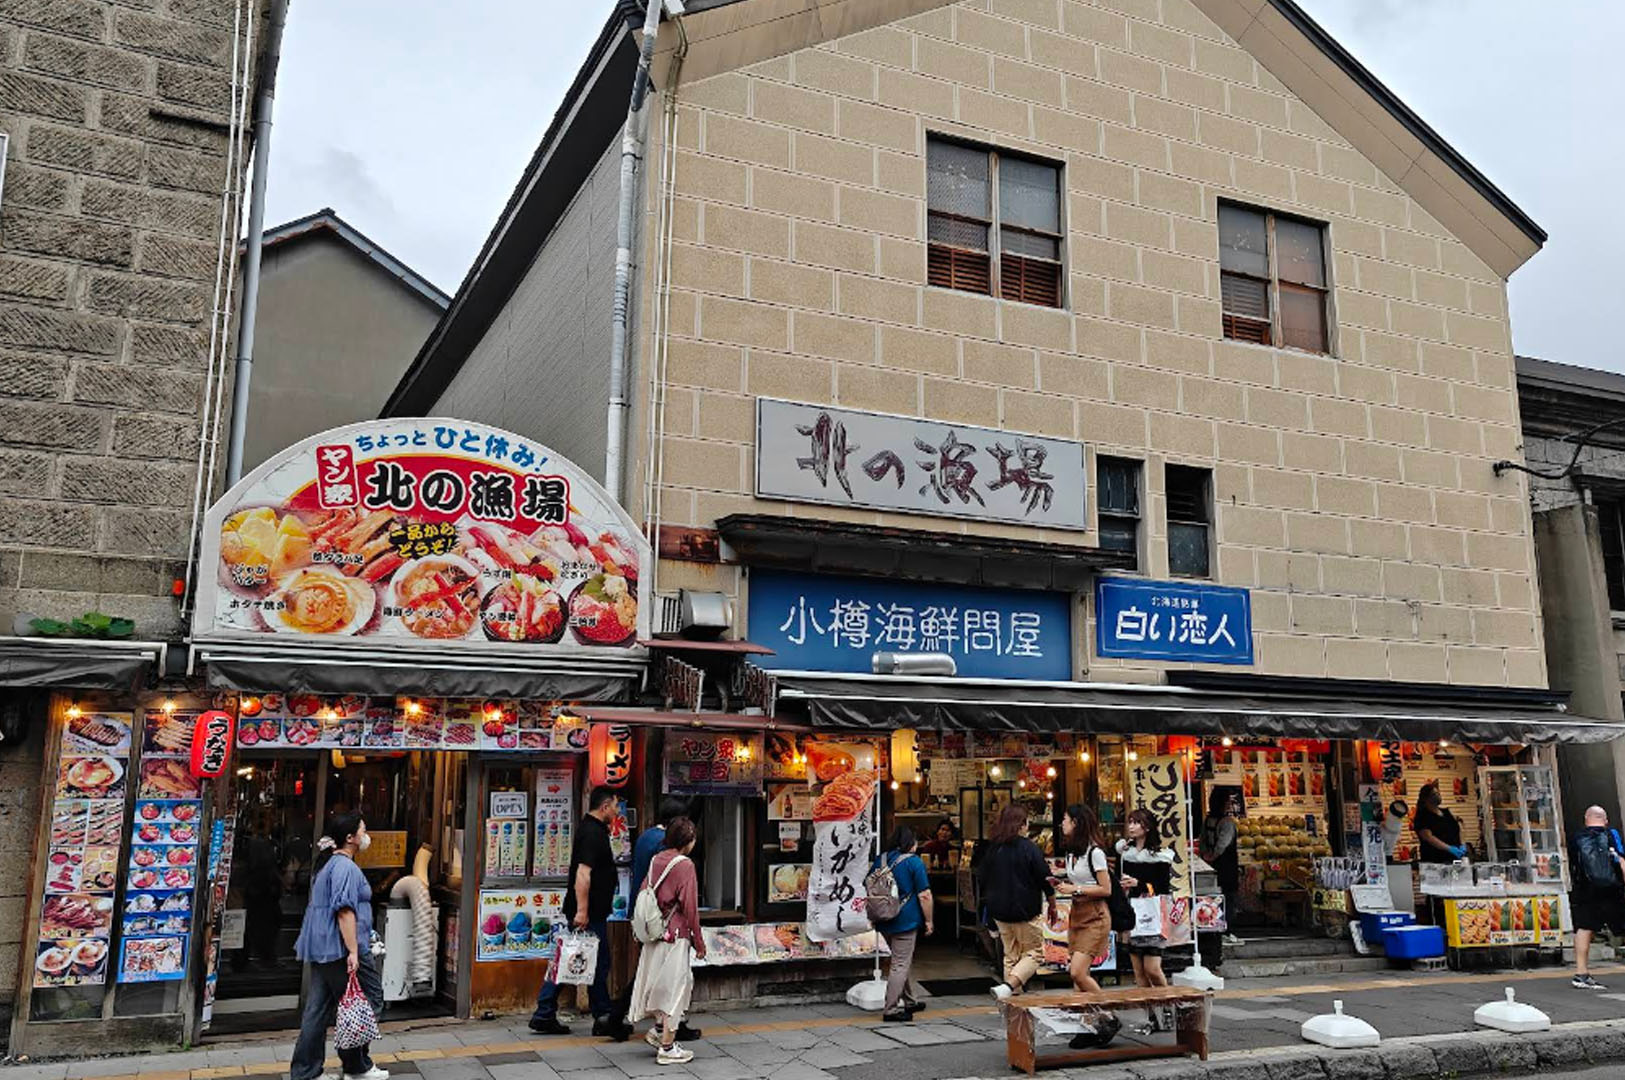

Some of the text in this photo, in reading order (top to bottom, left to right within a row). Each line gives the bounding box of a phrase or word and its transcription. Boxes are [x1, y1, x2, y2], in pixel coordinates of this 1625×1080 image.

[366, 463, 566, 521] 北の漁場
[391, 522, 455, 540] 一品から
[399, 539, 452, 557] どうぞ!
[780, 596, 1044, 658] 小樽海鮮問屋
[1116, 606, 1236, 647] 白い恋人
[202, 717, 229, 772] うなぎ
[606, 725, 631, 785] ラーメン
[829, 824, 856, 932] いかめし
